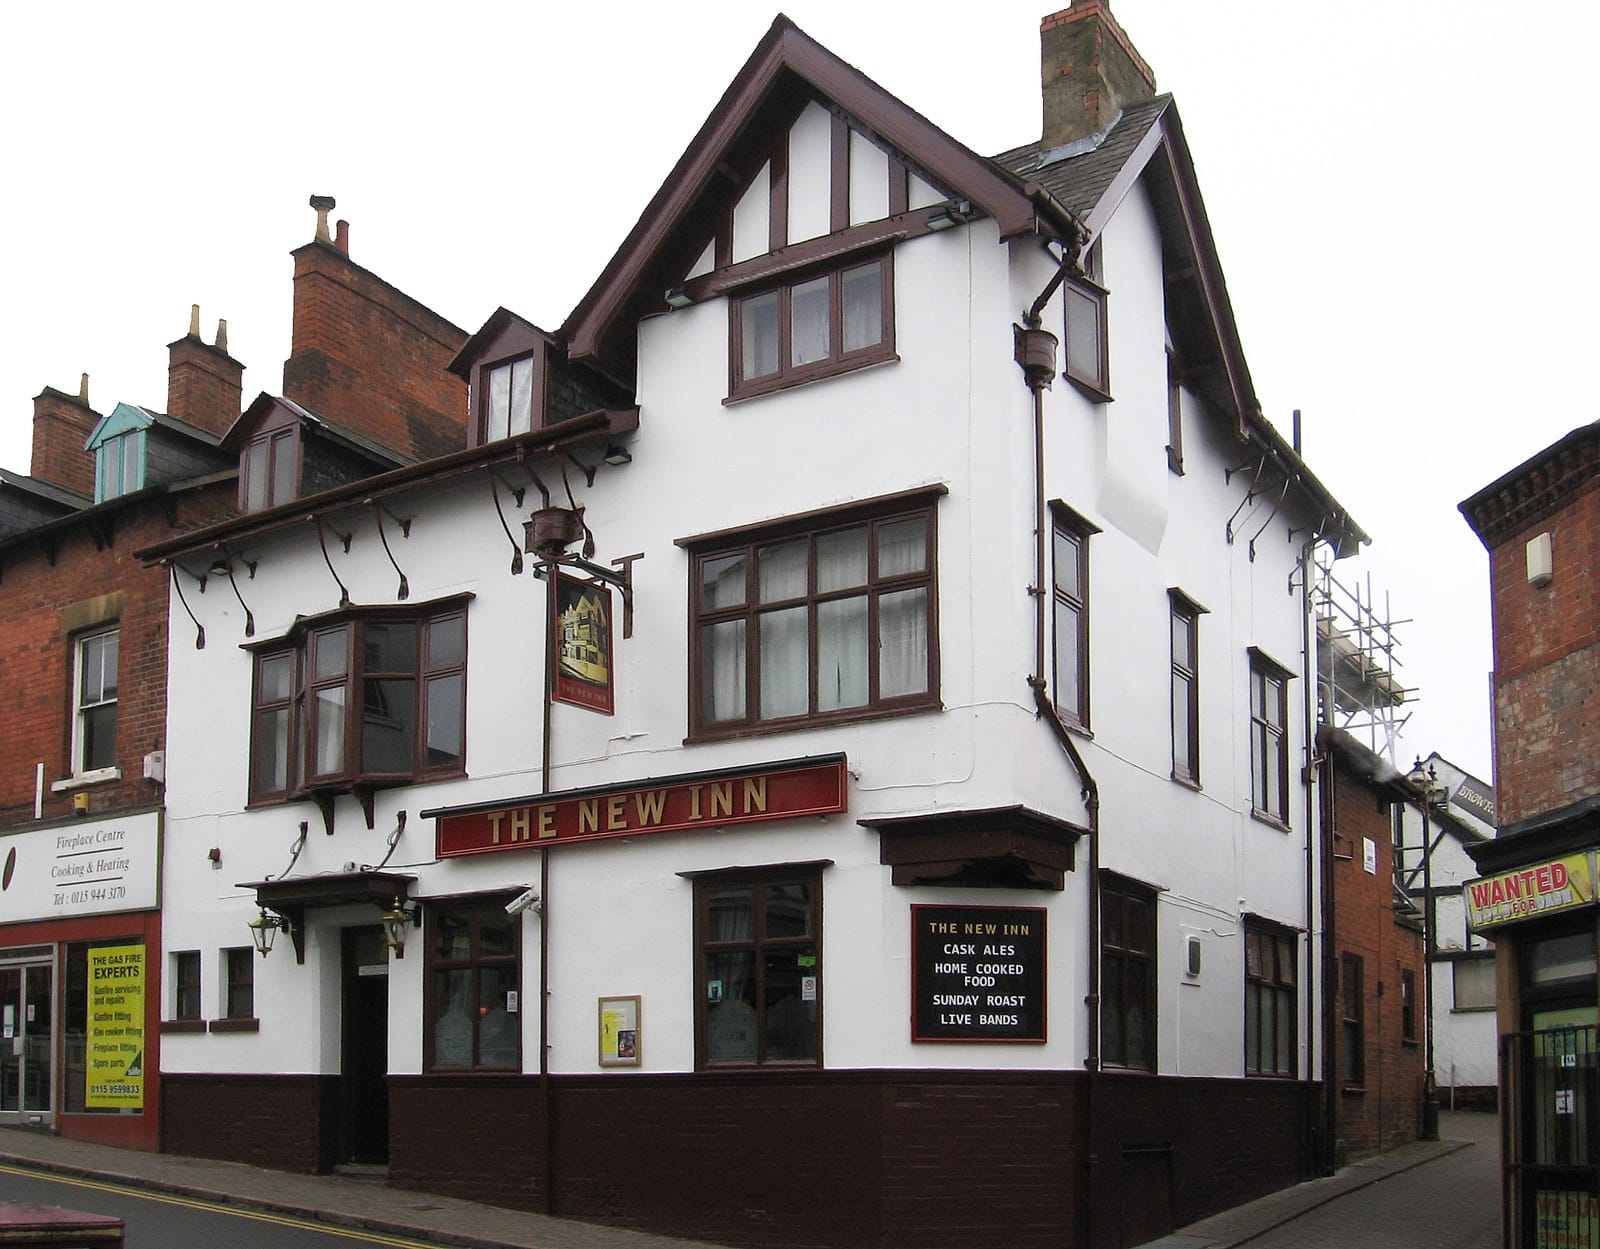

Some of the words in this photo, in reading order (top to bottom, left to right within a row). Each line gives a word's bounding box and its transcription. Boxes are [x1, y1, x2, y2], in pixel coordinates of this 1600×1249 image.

[487, 804, 557, 844] THE
[578, 789, 668, 834] NEW
[688, 777, 767, 821] INN
[56, 834, 94, 849] Fireplace
[96, 830, 125, 843] Centre
[51, 863, 85, 878] Cooking
[86, 861, 93, 874] &
[96, 857, 129, 872] Heating
[1469, 862, 1568, 909] WANTED
[71, 890, 89, 904] 0115
[90, 888, 106, 901] 944
[107, 886, 126, 900] 3170
[1512, 899, 1537, 913] FOR
[929, 922, 958, 934] THE
[965, 923, 997, 935] NEW
[1003, 924, 1029, 935] INN
[943, 944, 975, 955] CASK
[983, 945, 1015, 956] ALES
[92, 956, 107, 966] THE
[108, 955, 123, 965] GAS
[125, 954, 142, 963] FIRE
[94, 965, 140, 979] EXPERTS
[935, 963, 967, 974] HOME
[976, 964, 1024, 975] COOKED
[964, 976, 995, 987] FOOD
[94, 996, 104, 1005] and
[105, 996, 125, 1006] repairs
[933, 995, 979, 1006] SUNDAY
[987, 995, 1025, 1006] ROAST
[114, 1011, 132, 1022] fitting
[941, 1014, 972, 1025] LIVE
[980, 1014, 1018, 1025] BANDS
[93, 1028, 104, 1036] Gas
[105, 1027, 124, 1036] cooker
[125, 1027, 142, 1038] fitting
[93, 1058, 108, 1069] Spare
[110, 1059, 125, 1069] parts
[91, 1085, 107, 1093] 0115
